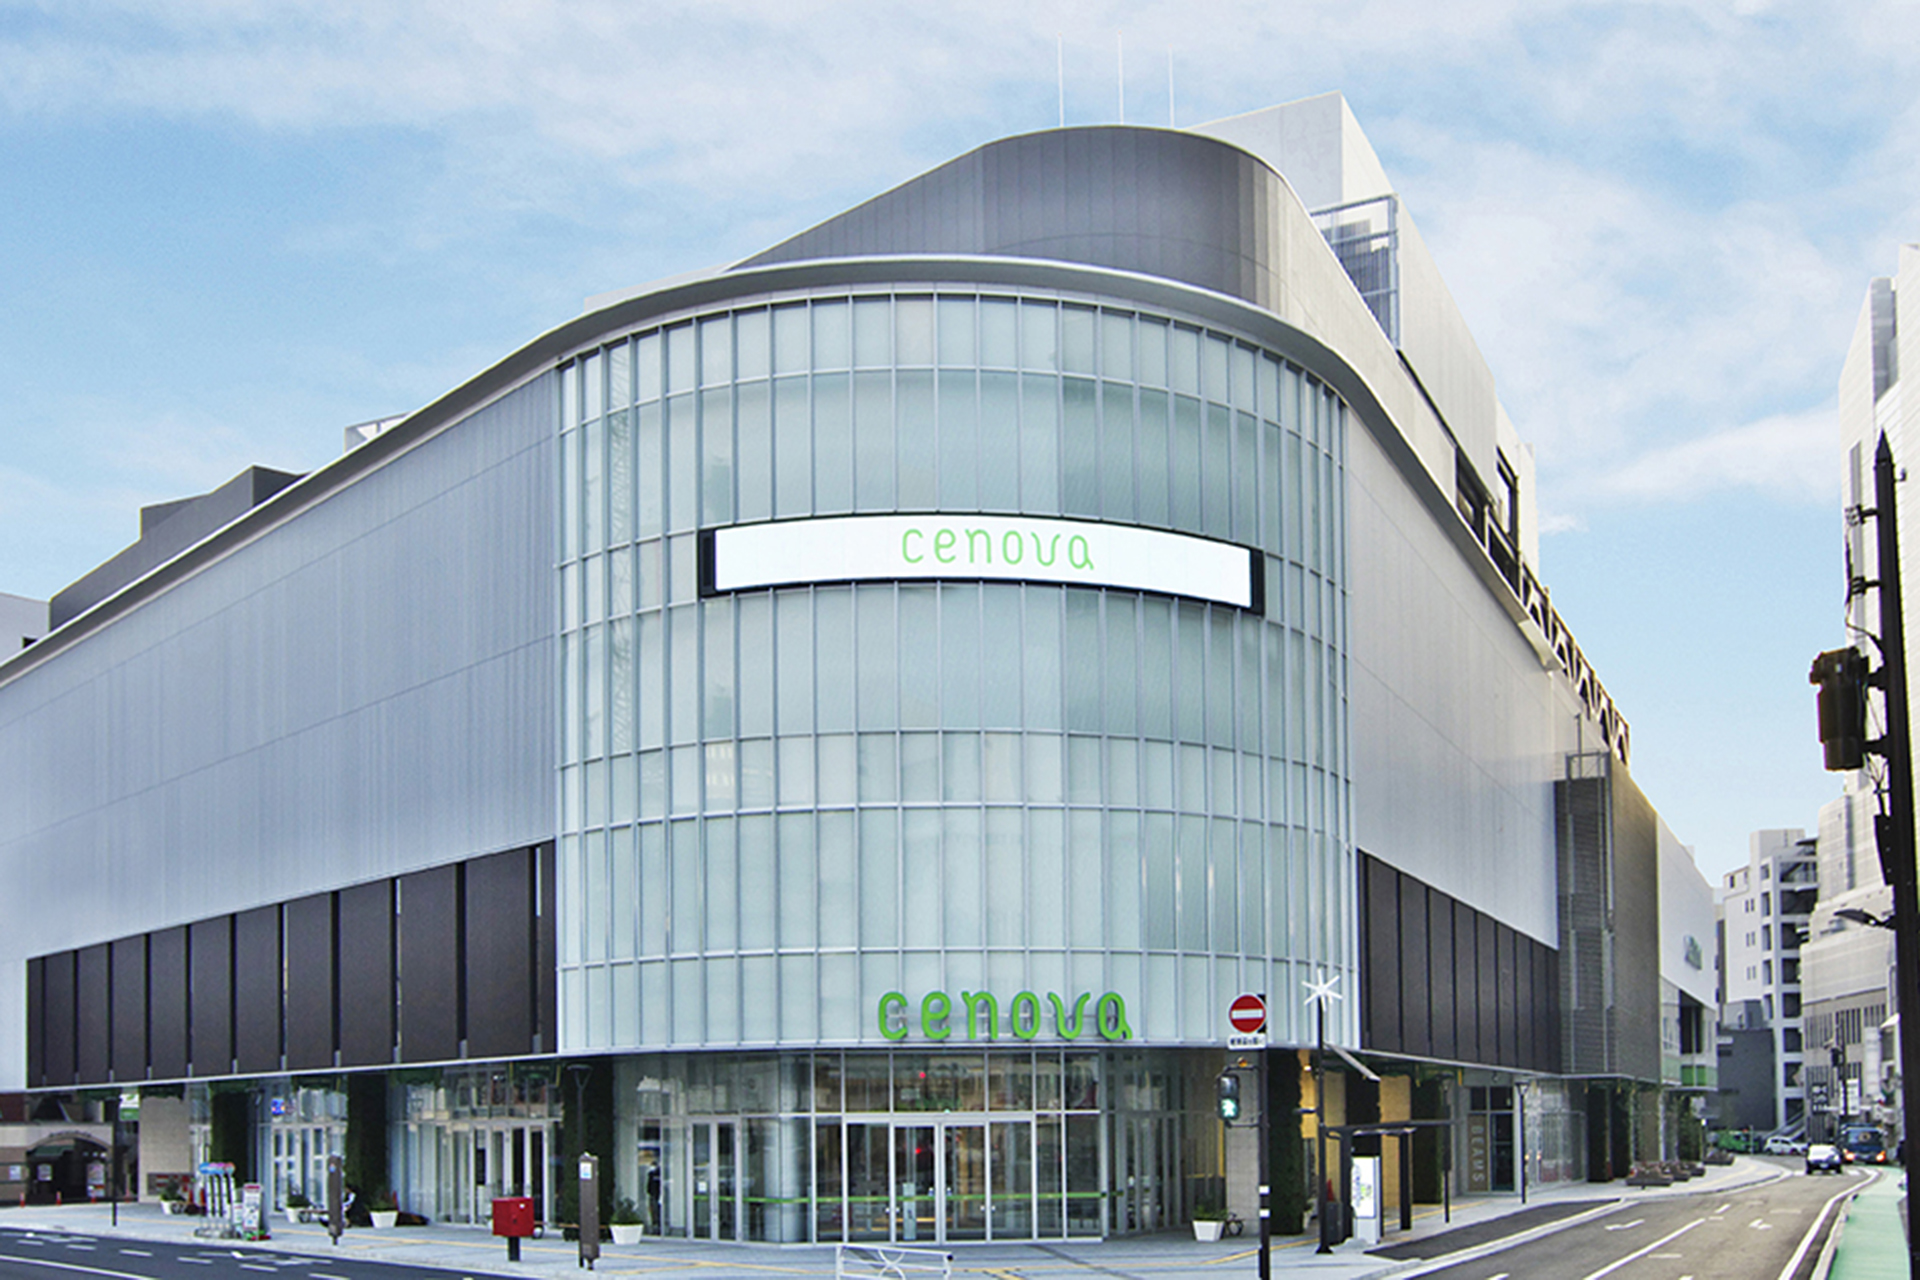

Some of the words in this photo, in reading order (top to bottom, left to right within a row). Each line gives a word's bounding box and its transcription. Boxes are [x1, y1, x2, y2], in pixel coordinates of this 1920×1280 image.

[902, 528, 1095, 570] cenova
[878, 990, 1133, 1041] cenova
[1470, 1125, 1485, 1182] BEAMS
